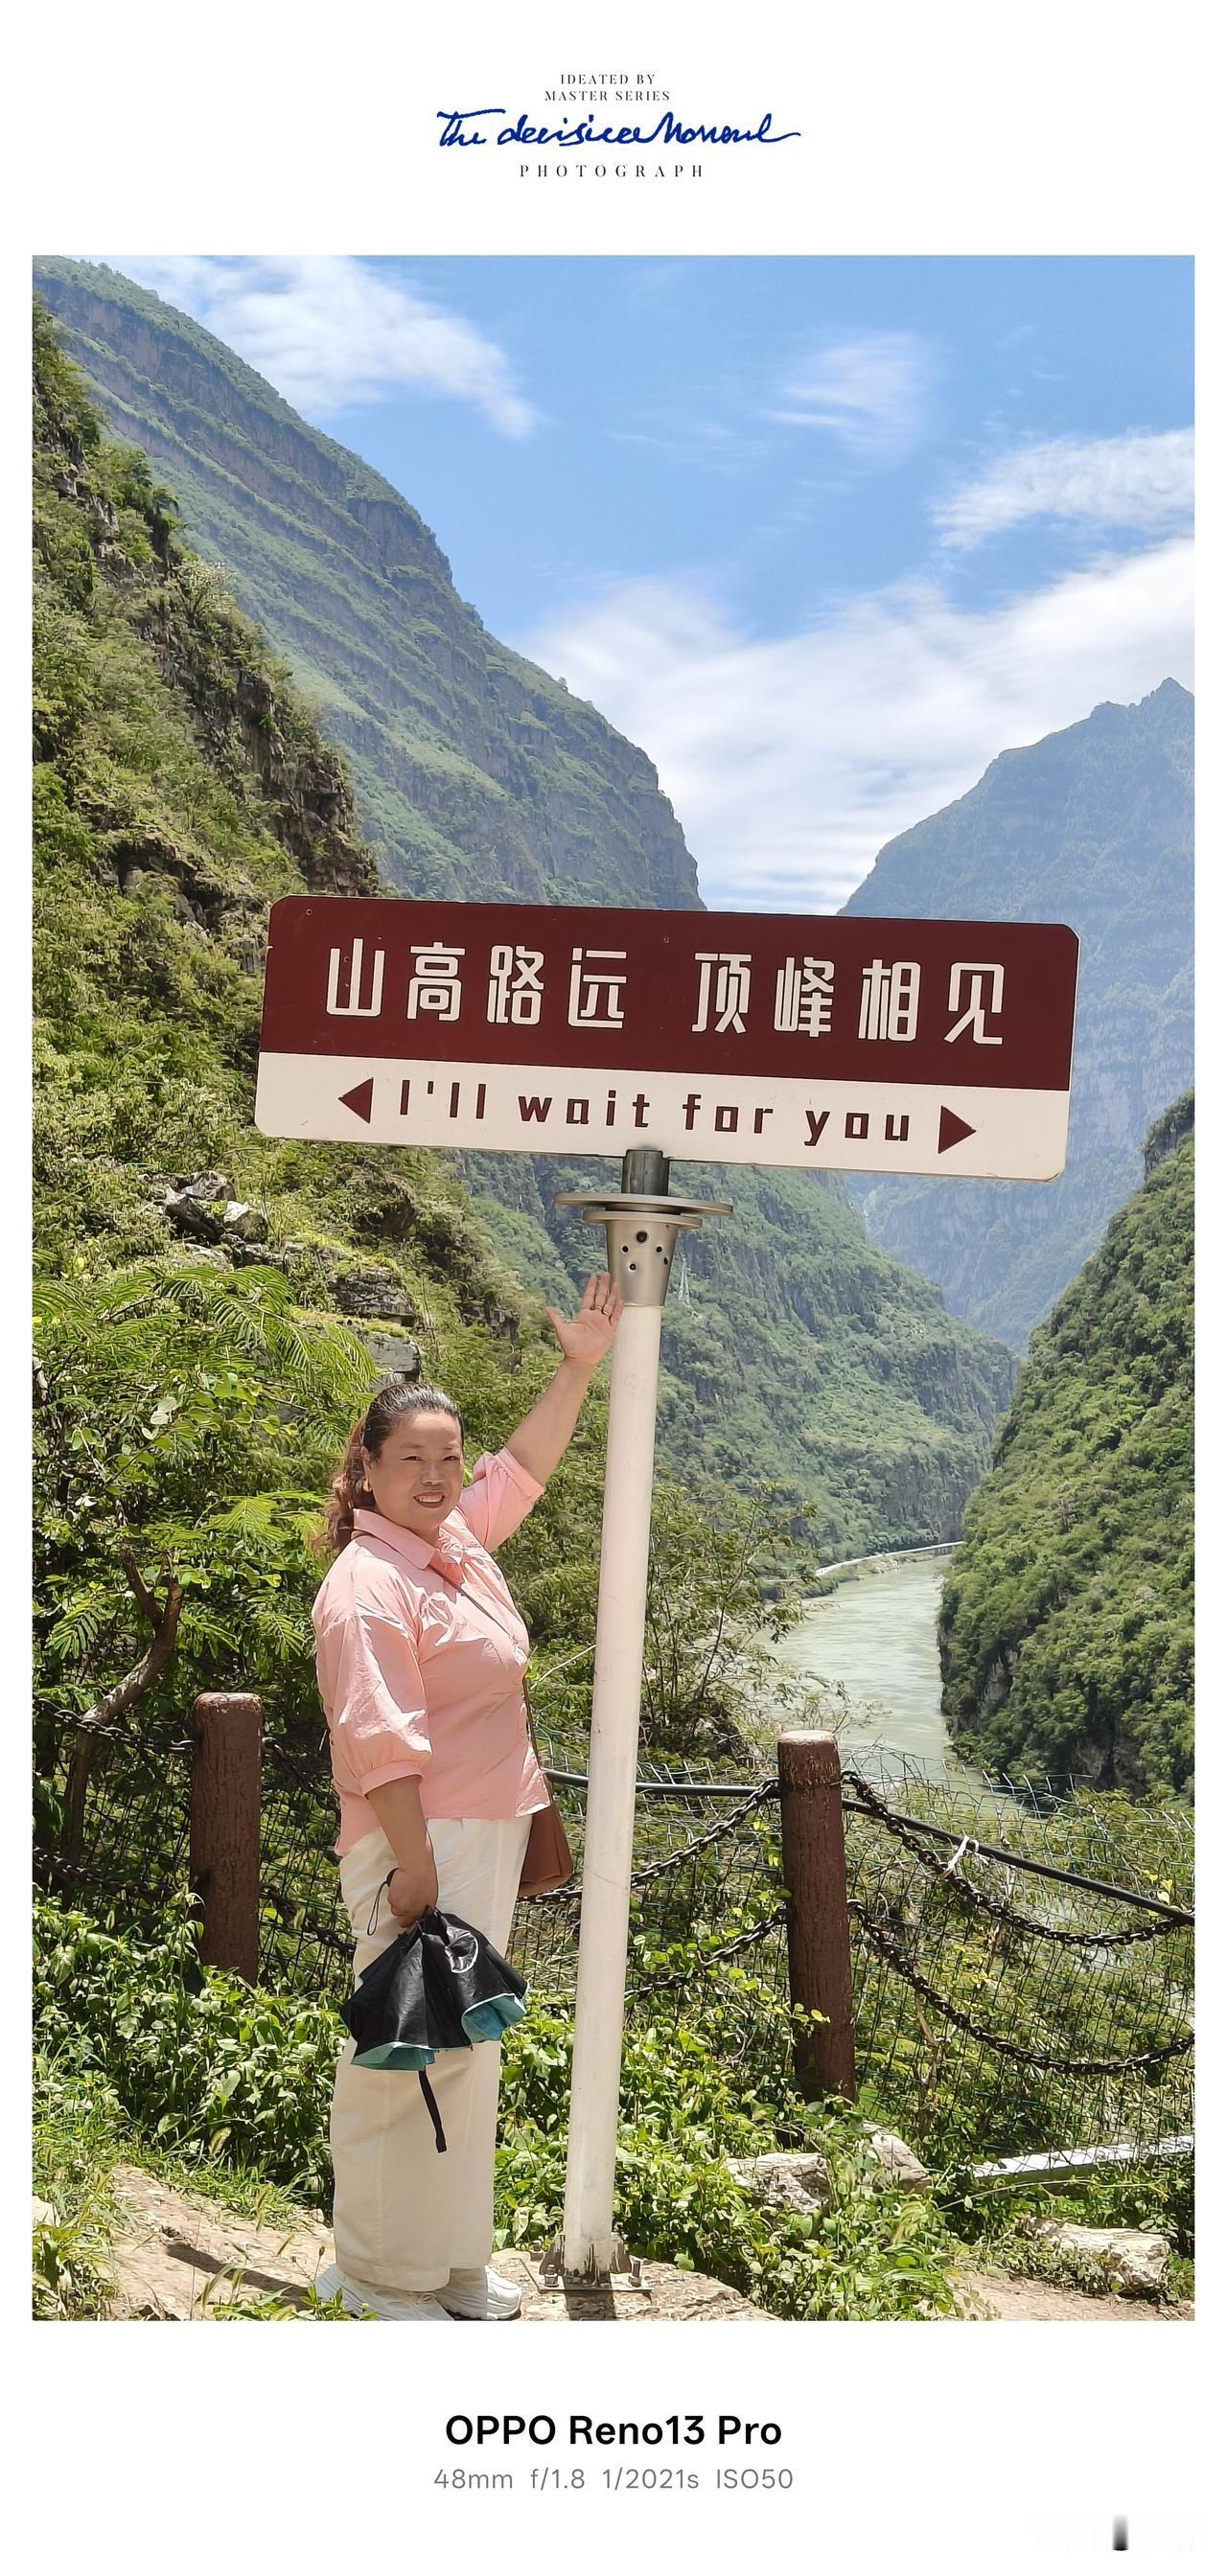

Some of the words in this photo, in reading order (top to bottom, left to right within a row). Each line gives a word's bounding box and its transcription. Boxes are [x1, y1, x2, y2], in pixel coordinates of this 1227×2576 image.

[326, 937, 628, 1029] 山高路远
[691, 953, 1006, 1046] 顶峰相见
[399, 1079, 487, 1120] I'll
[518, 1090, 651, 1128] wait
[682, 1093, 774, 1135] for
[803, 1110, 911, 1147] you
